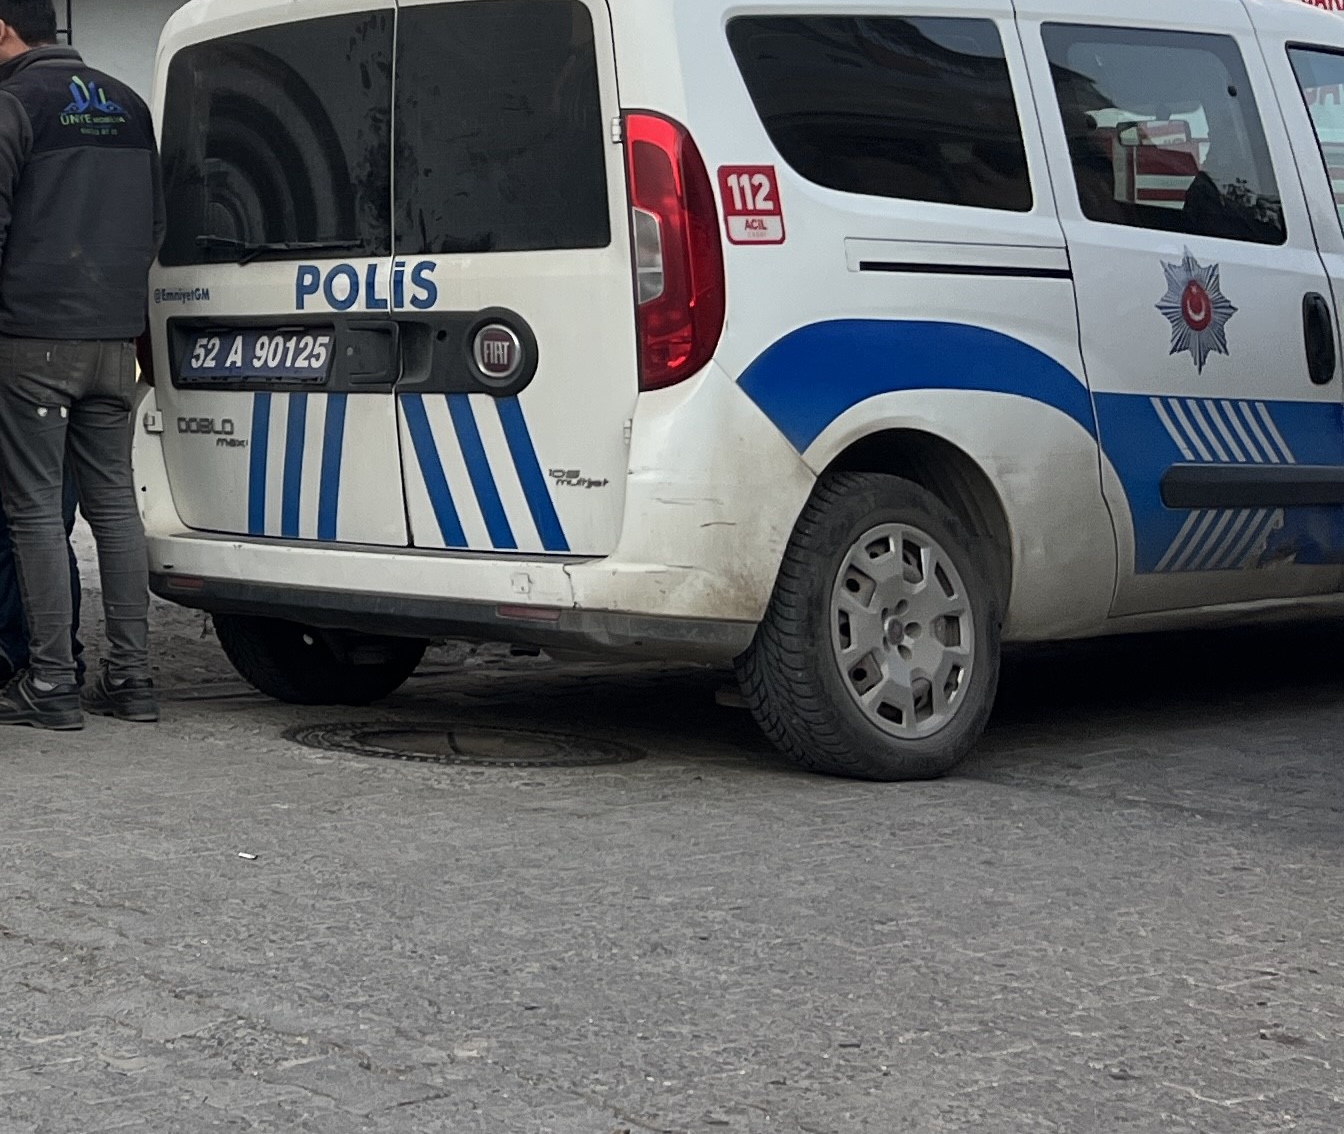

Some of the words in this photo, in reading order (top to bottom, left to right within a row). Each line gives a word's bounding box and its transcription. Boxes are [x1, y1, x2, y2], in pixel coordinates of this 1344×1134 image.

[727, 173, 774, 211] 112
[191, 336, 220, 368] 52
[224, 335, 243, 367] A
[252, 335, 330, 369] 90125
[483, 340, 510, 365] FIAT
[178, 417, 234, 436] DOBLO
